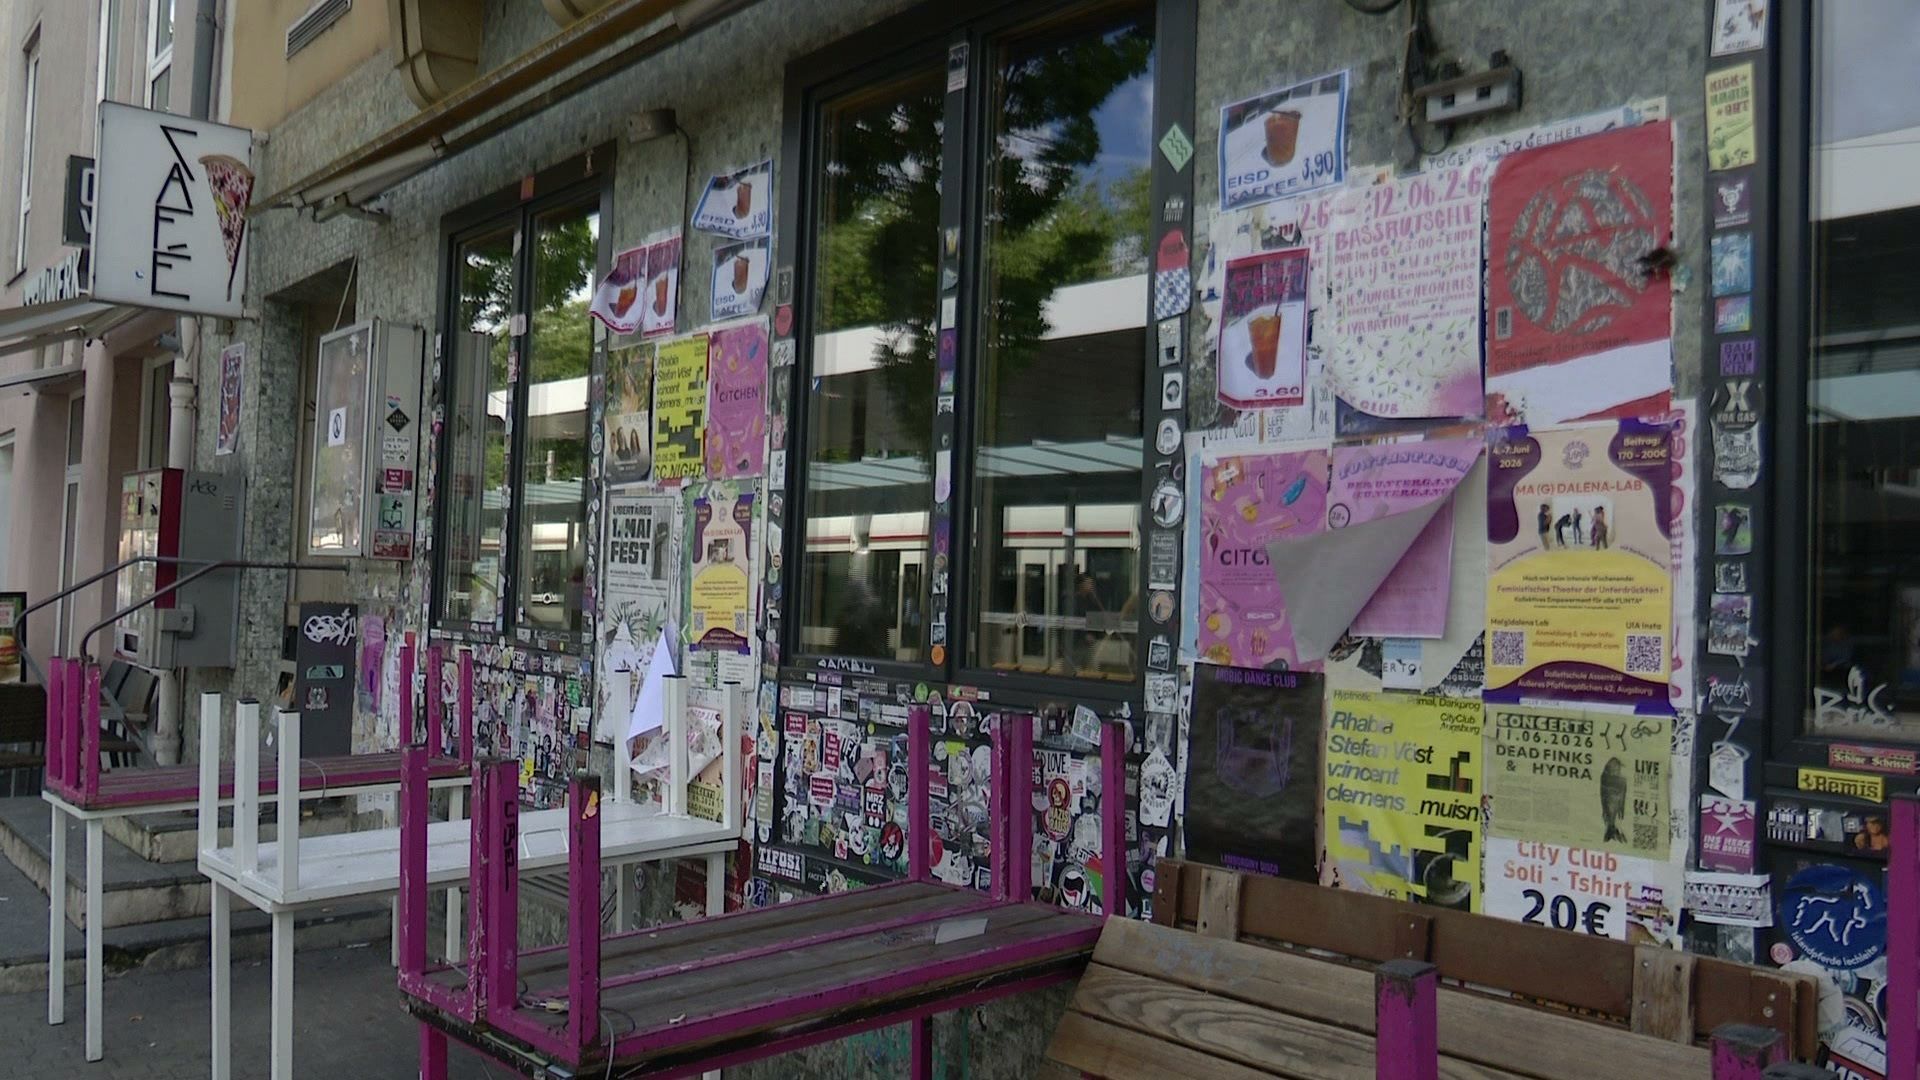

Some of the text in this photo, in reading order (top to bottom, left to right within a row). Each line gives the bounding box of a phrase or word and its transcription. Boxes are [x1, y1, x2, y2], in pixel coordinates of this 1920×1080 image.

[1228, 169, 1270, 189] EISD
[1228, 177, 1298, 204] KAFFEE
[719, 386, 759, 403] CITCHEN
[1255, 386, 1300, 398] 3.60
[1499, 458, 1521, 469] 2026
[610, 541, 649, 565] FEST
[1496, 712, 1594, 735] CONCERTS
[1496, 744, 1593, 765] DEAD FINKS
[1506, 760, 1593, 781] & HYDRA
[1634, 758, 1660, 775] LIVE
[1326, 783, 1406, 811] clemens
[865, 803, 885, 815] LCK
[1517, 840, 1618, 873] City Club
[1504, 859, 1544, 885] Soli
[1567, 870, 1632, 900] Tshirt
[1522, 888, 1612, 939] 20€
